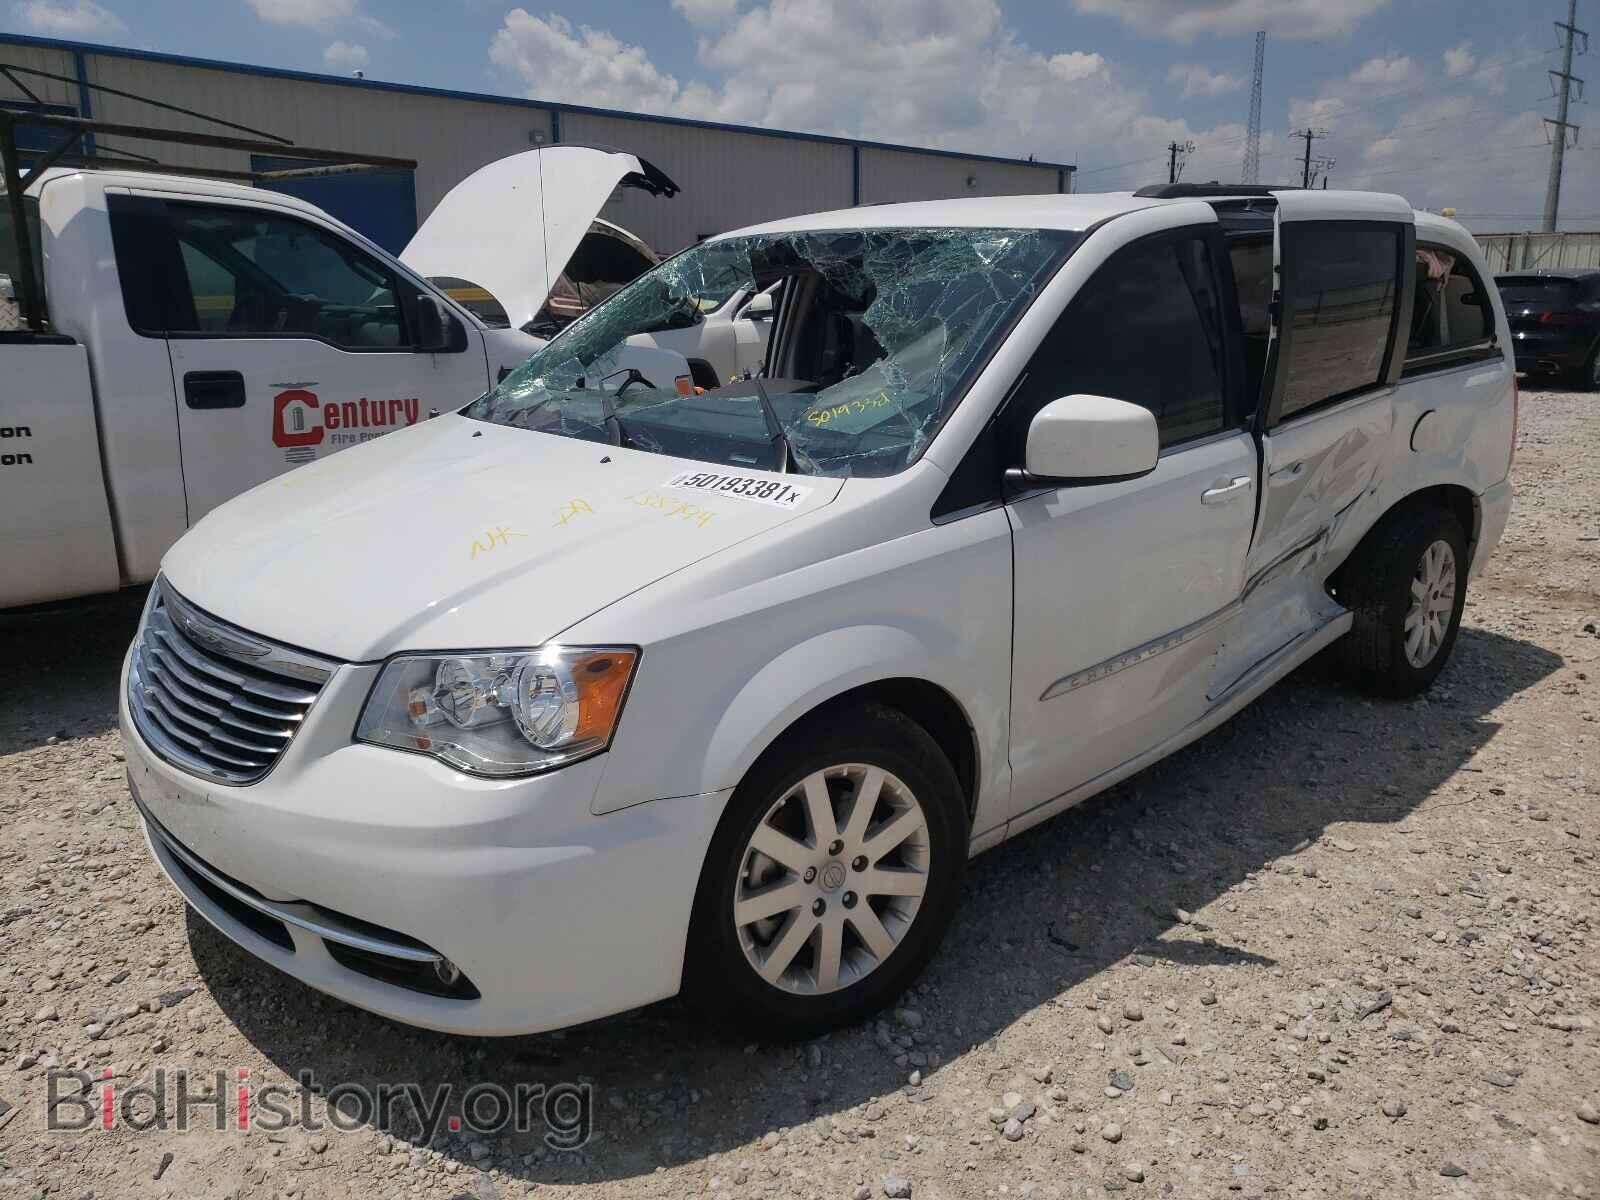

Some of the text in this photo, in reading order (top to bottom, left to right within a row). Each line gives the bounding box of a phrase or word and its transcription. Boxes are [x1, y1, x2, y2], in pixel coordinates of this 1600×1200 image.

[272, 389, 419, 448] Century
[331, 433, 357, 445] Fire
[1, 453, 33, 466] on
